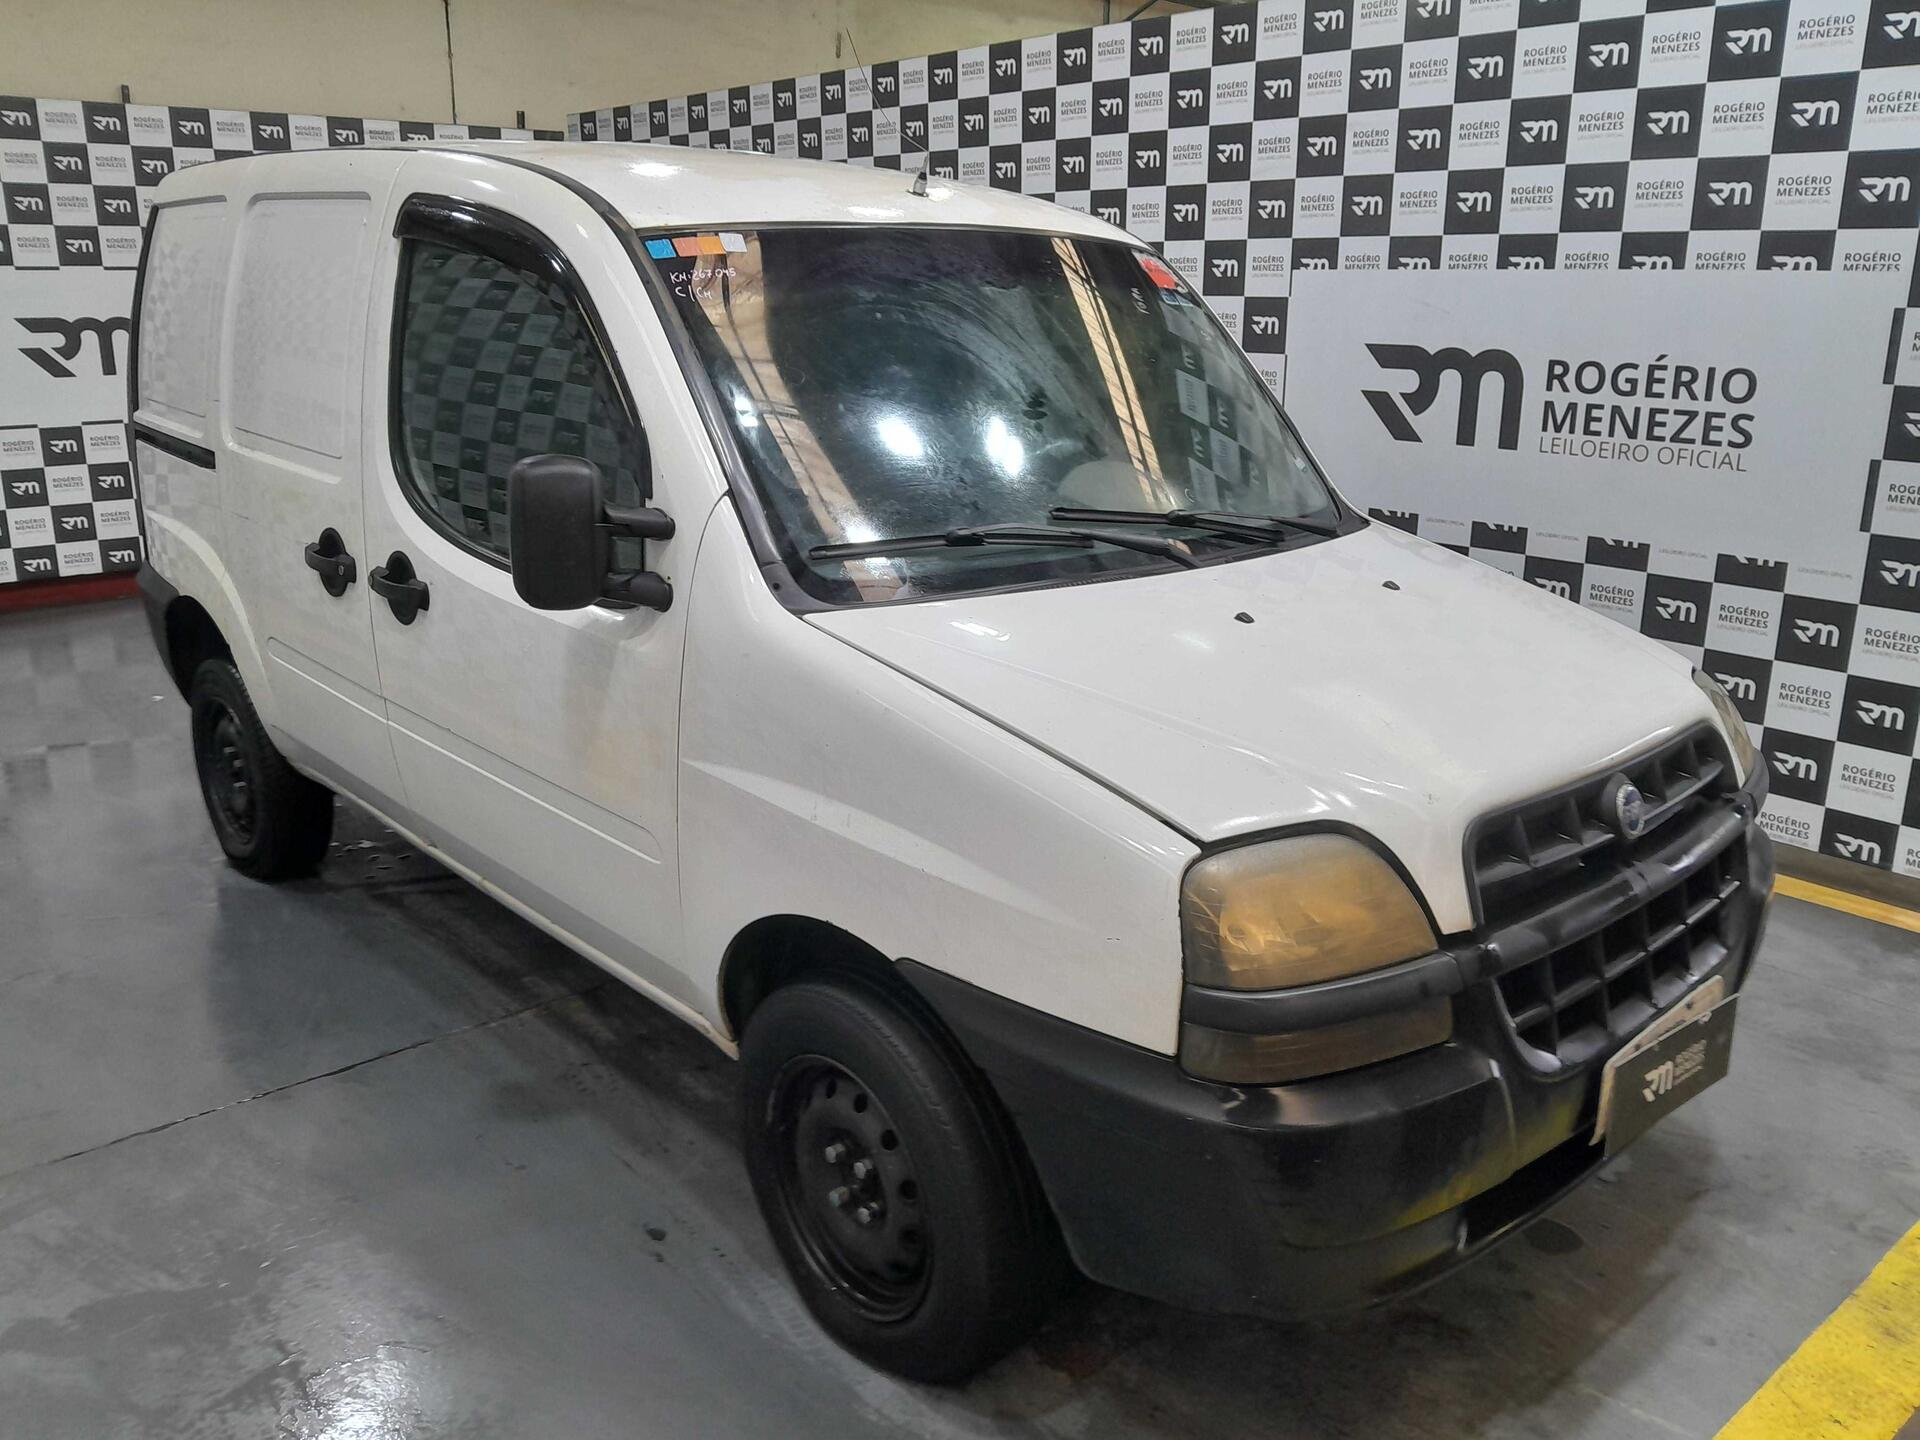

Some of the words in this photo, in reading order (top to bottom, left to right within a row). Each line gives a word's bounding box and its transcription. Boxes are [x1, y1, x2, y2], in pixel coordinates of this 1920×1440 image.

[1263, 12, 1297, 25] ROGÉRIO
[1360, 6, 1398, 20] MENEZES
[1263, 21, 1297, 33] MENEZES
[1798, 14, 1855, 30] ROGÉRIO
[1651, 30, 1701, 45] ROGÉRIO
[1796, 25, 1855, 41] MENEZES
[1523, 45, 1567, 58] ROGÉRIO
[1650, 41, 1701, 55] MENEZES
[1409, 57, 1448, 70] ROGÉRIO
[1522, 54, 1567, 68] MENEZES
[1307, 69, 1342, 81] ROGÉRIO
[1408, 67, 1448, 79] MENEZES
[1216, 80, 1248, 91] ROGÉRIO
[1306, 78, 1342, 90] MENEZES
[1216, 88, 1248, 99] MENEZES
[1868, 90, 1920, 103] ROGÉRI
[1713, 101, 1765, 114] ROGÉRIO
[1866, 102, 1920, 114] MENEZE
[1578, 110, 1625, 123] ROGÉRIO
[1711, 112, 1765, 125] MENEZES
[1459, 119, 1500, 131] ROGÉRIO
[1577, 121, 1624, 133] MENEZES
[1352, 128, 1389, 139] ROGÉRIO
[1458, 129, 1500, 141] MENEZES
[1258, 135, 1291, 146] ROGÉRIO
[1352, 138, 1389, 148] MENEZES
[1257, 144, 1291, 154] MENEZES
[1636, 179, 1684, 191] ROGÉRIO
[1777, 174, 1832, 187] ROGÉRIO
[1399, 189, 1438, 199] ROGÉRIO
[1510, 184, 1553, 195] ROGÉRIO
[1635, 190, 1684, 201] MENEZES
[1776, 186, 1832, 197] MENEZES
[1211, 197, 1243, 207] ROGÉRIO
[1300, 193, 1335, 203] ROGÉRIO
[1399, 199, 1438, 208] MENEZES
[1510, 195, 1553, 205] MENEZES
[1211, 207, 1243, 215] MENEZES
[1300, 203, 1335, 212] MENEZES
[1252, 254, 1284, 263] ROGÉRIO
[1344, 253, 1380, 262] ROGÉRIO
[1448, 252, 1488, 262] ROGÉRIO
[1564, 251, 1609, 261] ROGÉRIO
[1696, 250, 1747, 261] ROGÉRIO
[1843, 250, 1902, 262] ROGÉRIO
[1545, 354, 1758, 403] ROGÉRIO
[1541, 400, 1755, 449] MENEZES
[1539, 436, 1649, 463] LEILOEIRO
[1657, 446, 1748, 472] OFICIAL
[1590, 583, 1634, 598] ROGÉRIO
[1589, 592, 1634, 607] MENEZES
[1719, 604, 1769, 619] ROGÉRIO
[1718, 613, 1769, 629] MENEZES
[1865, 627, 1920, 644] ROGÉRIO
[1863, 637, 1920, 655] MENEZES
[1779, 682, 1832, 700] ROGÉRIO
[1778, 691, 1831, 709] MENEZES
[1842, 763, 1897, 783] ROGÉRIO
[1840, 773, 1896, 793] MENEZES
[1760, 812, 1810, 830] ROGÉRIO
[1760, 820, 1809, 840] MENEZES
